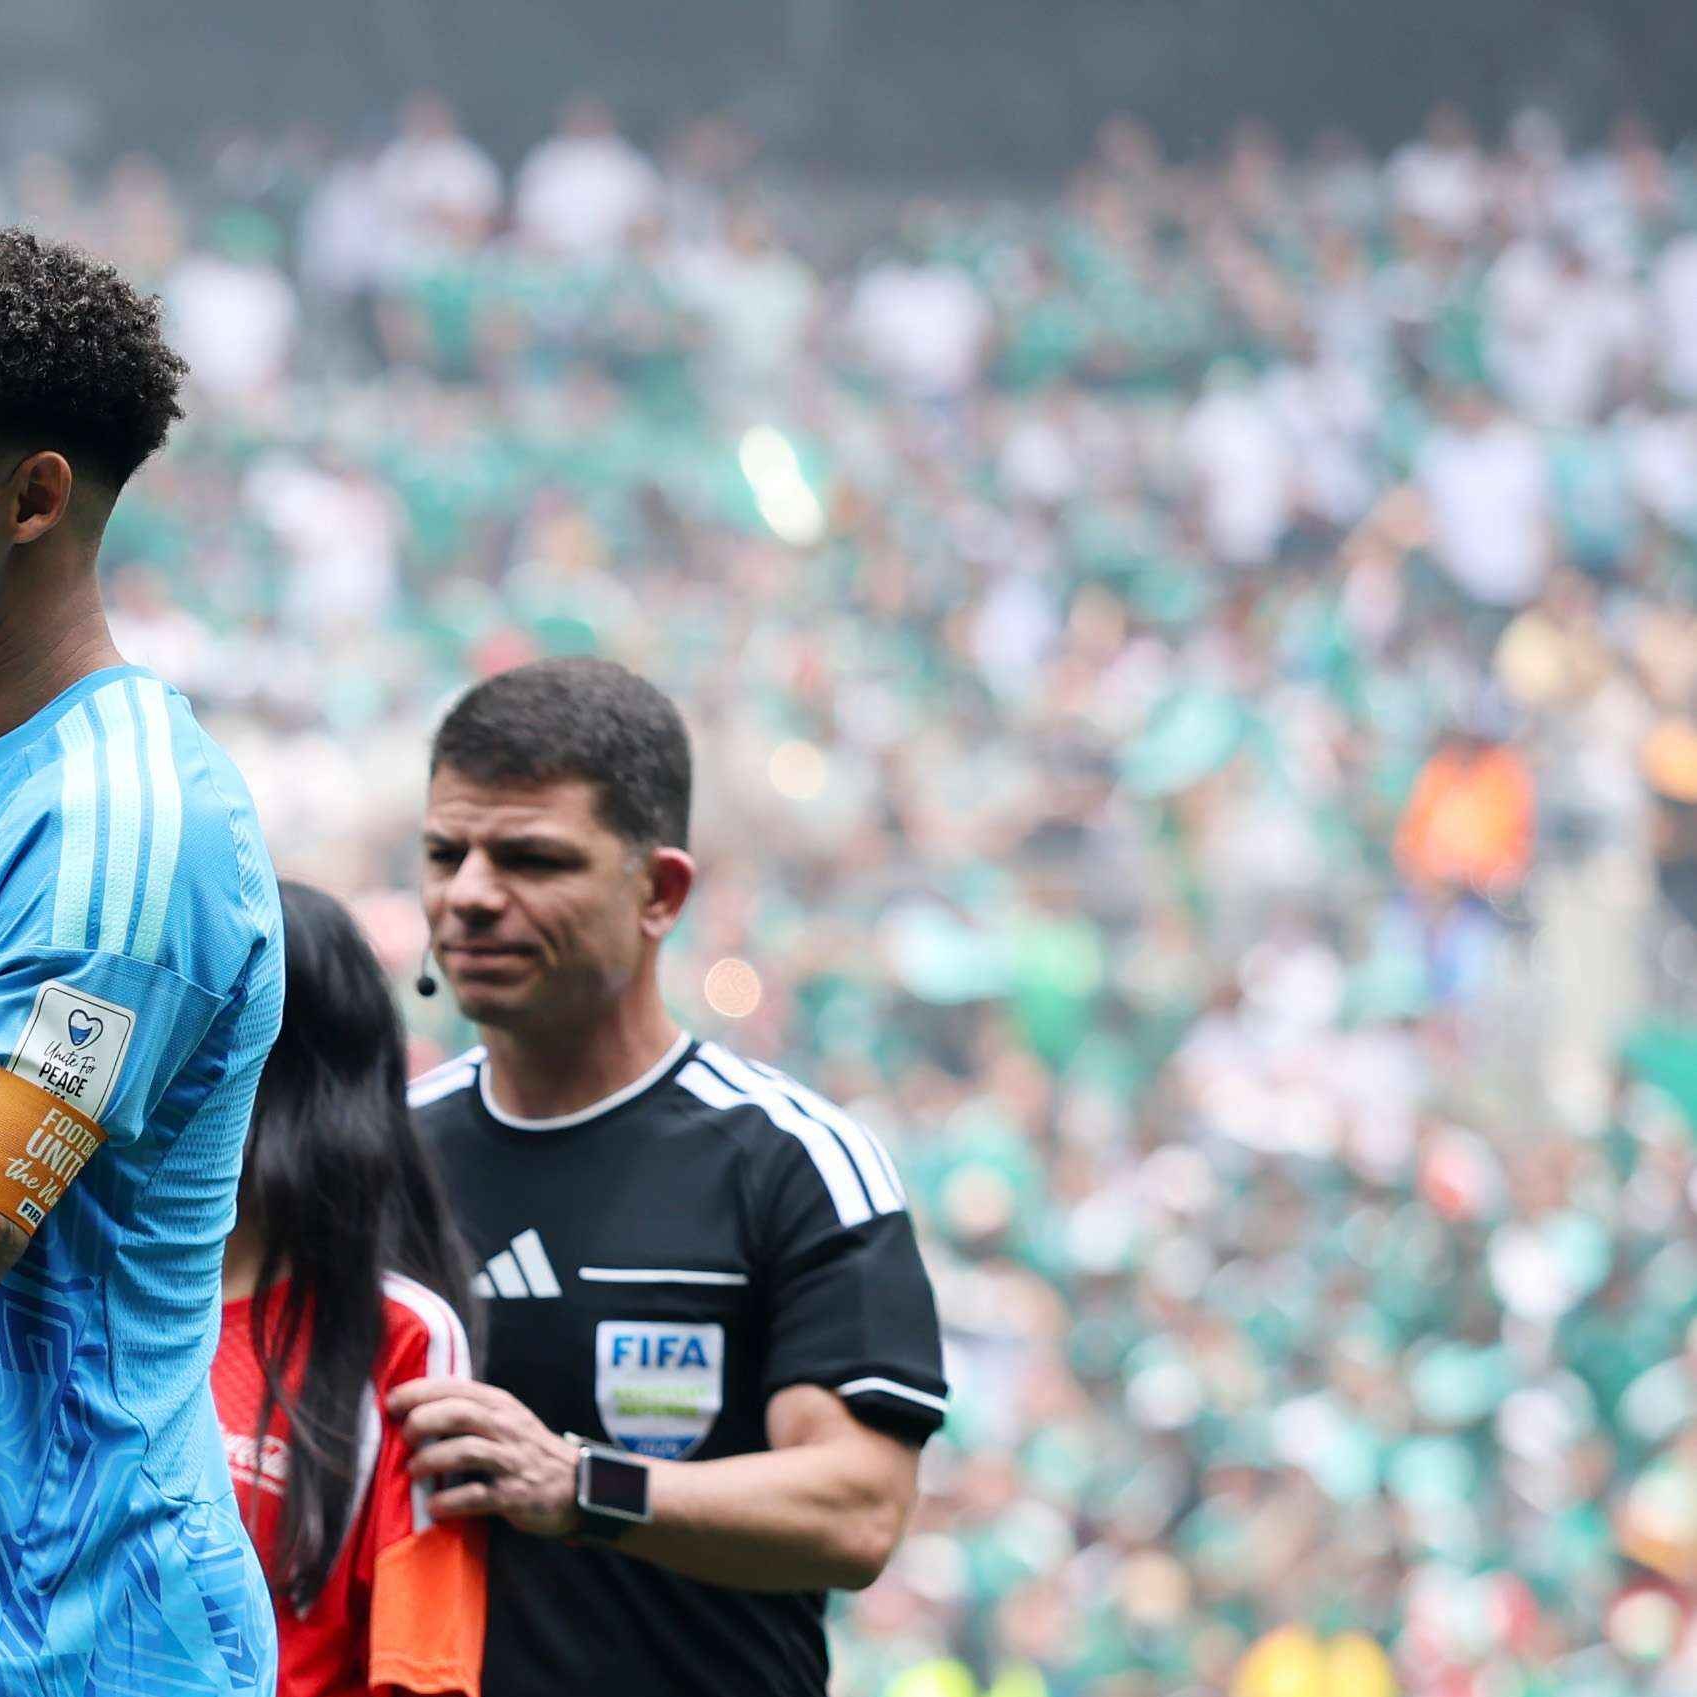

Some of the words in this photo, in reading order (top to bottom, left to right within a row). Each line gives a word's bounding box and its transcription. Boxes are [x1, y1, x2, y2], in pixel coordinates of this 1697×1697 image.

[44, 1040, 78, 1068] Unite
[79, 1055, 97, 1075] For
[39, 1062, 88, 1098] PEACE
[42, 1107, 99, 1160] FOOTB
[5, 1157, 40, 1189] the
[26, 1127, 85, 1186] UNIT
[613, 1334, 709, 1368] FIFA
